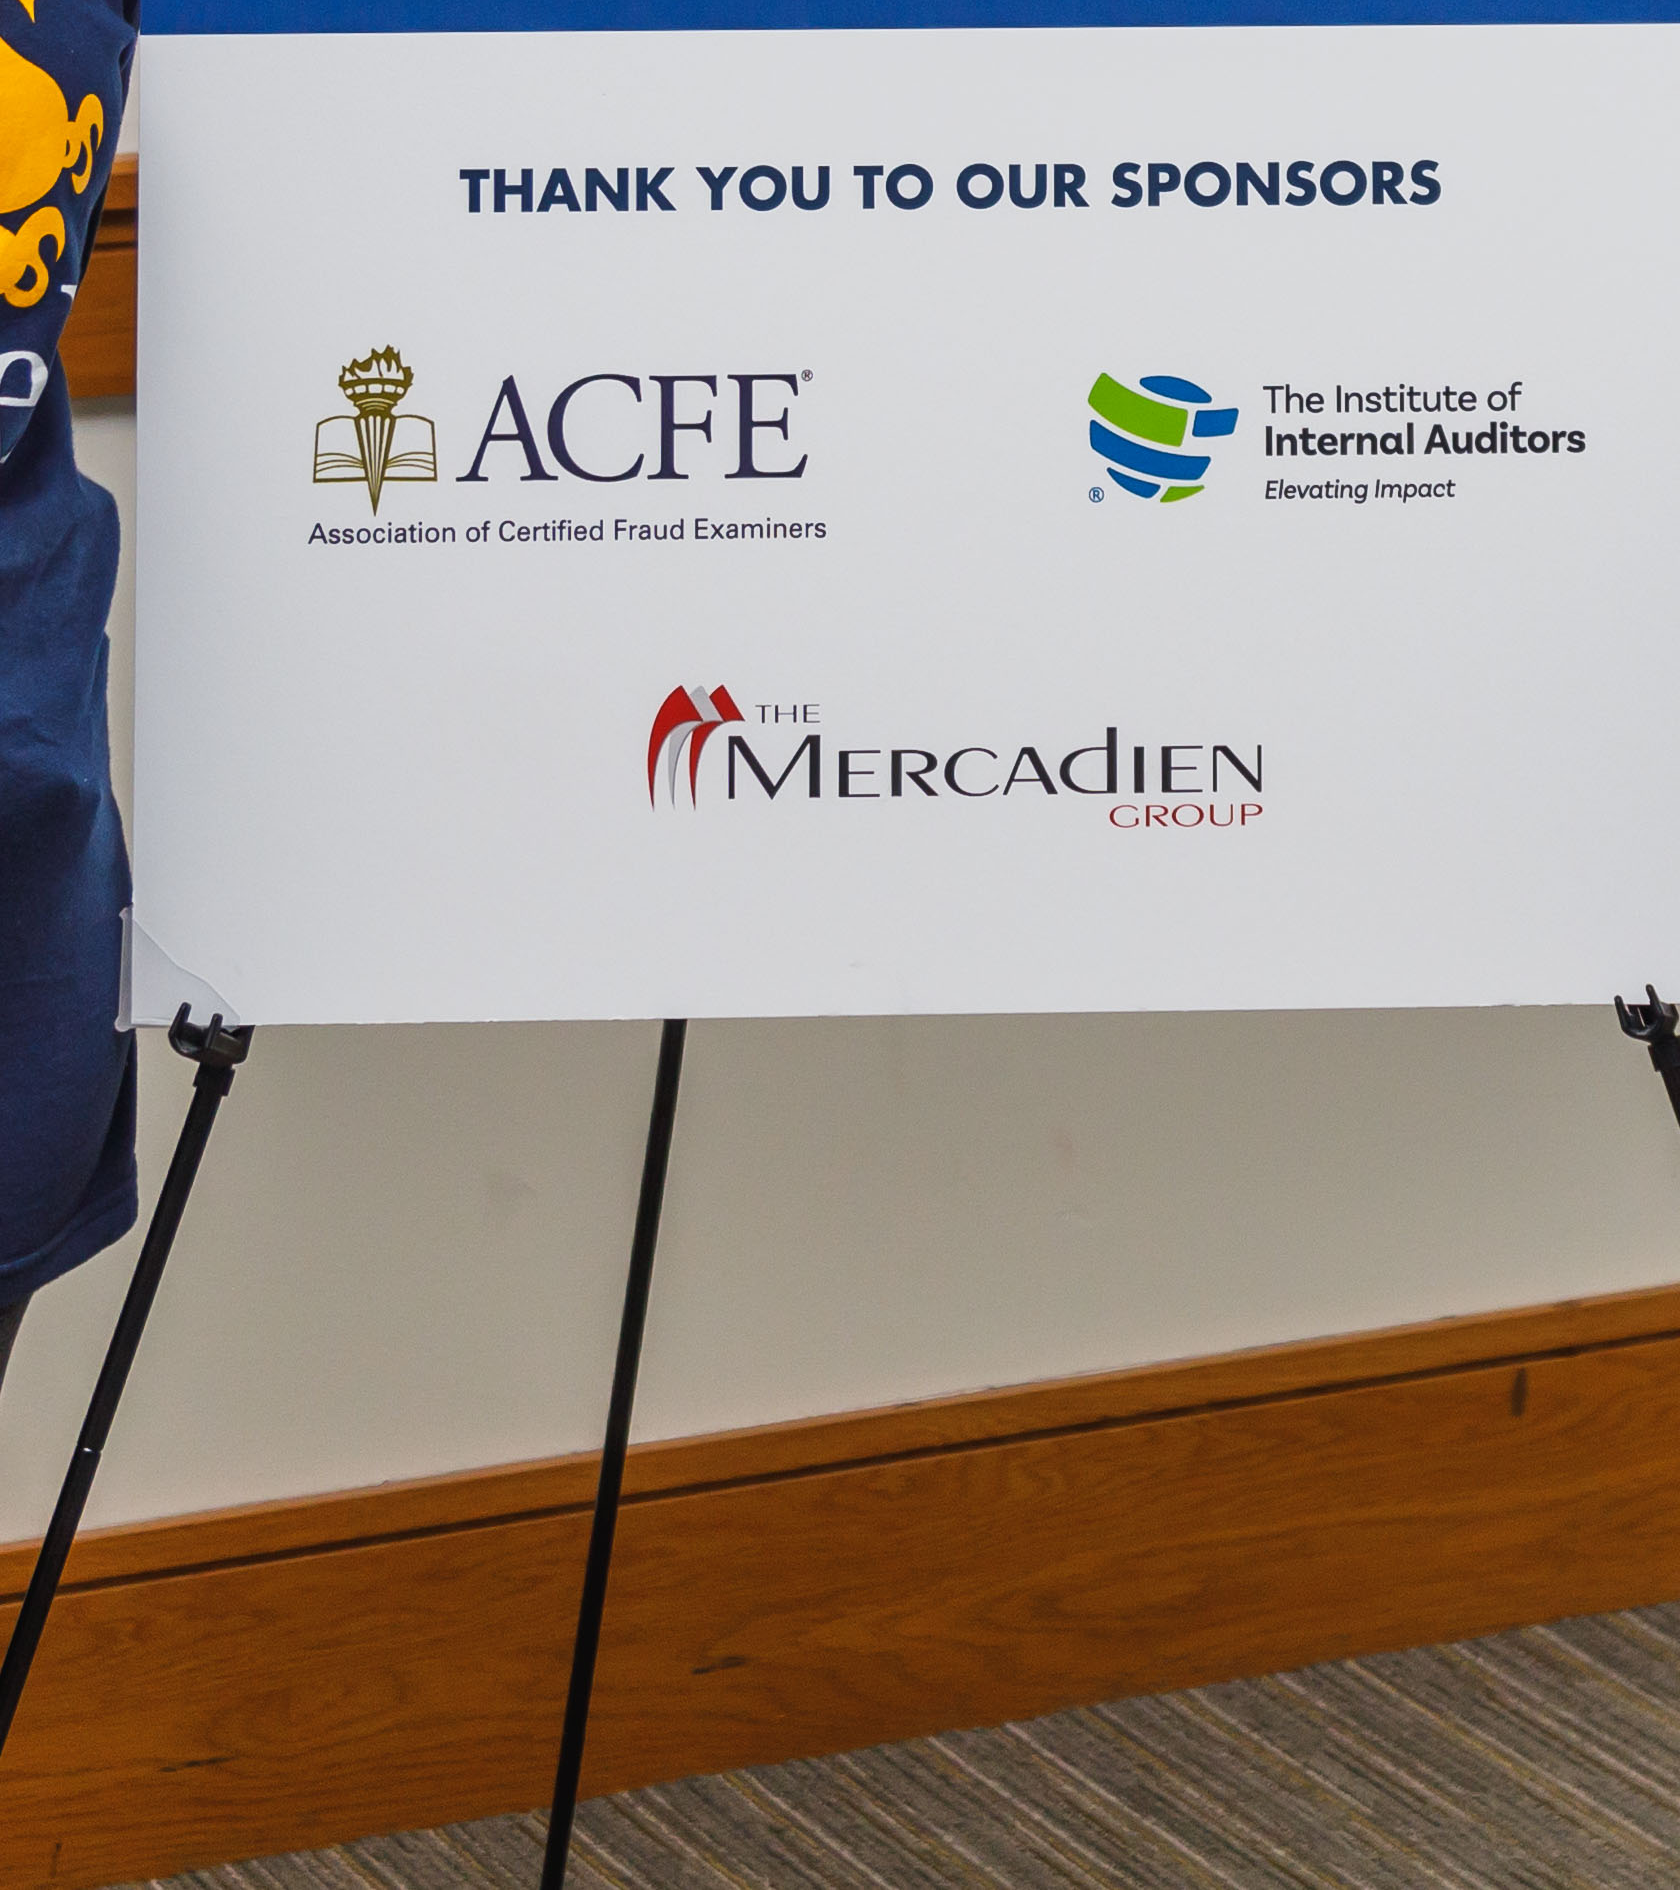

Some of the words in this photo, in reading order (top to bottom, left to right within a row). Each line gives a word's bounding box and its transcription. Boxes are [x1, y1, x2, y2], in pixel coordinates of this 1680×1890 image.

[459, 166, 677, 214] THANK
[695, 164, 831, 212] YOU
[852, 163, 934, 211] TO
[956, 162, 1090, 210] OUR
[1110, 159, 1442, 209] SPONSORS
[1262, 383, 1325, 414] The
[1336, 383, 1478, 414] Institute
[1486, 381, 1523, 412] of
[1265, 421, 1415, 457] Internal
[1423, 420, 1586, 455] Auditors
[1264, 478, 1369, 504] Elevating
[1374, 478, 1457, 504] Impact
[307, 521, 456, 545] Association
[465, 520, 492, 543] of
[498, 519, 604, 543] Certified
[614, 518, 685, 541] Fraud
[694, 517, 827, 540] Examiners
[754, 703, 821, 724] THE
[1108, 803, 1264, 829] GROUP
